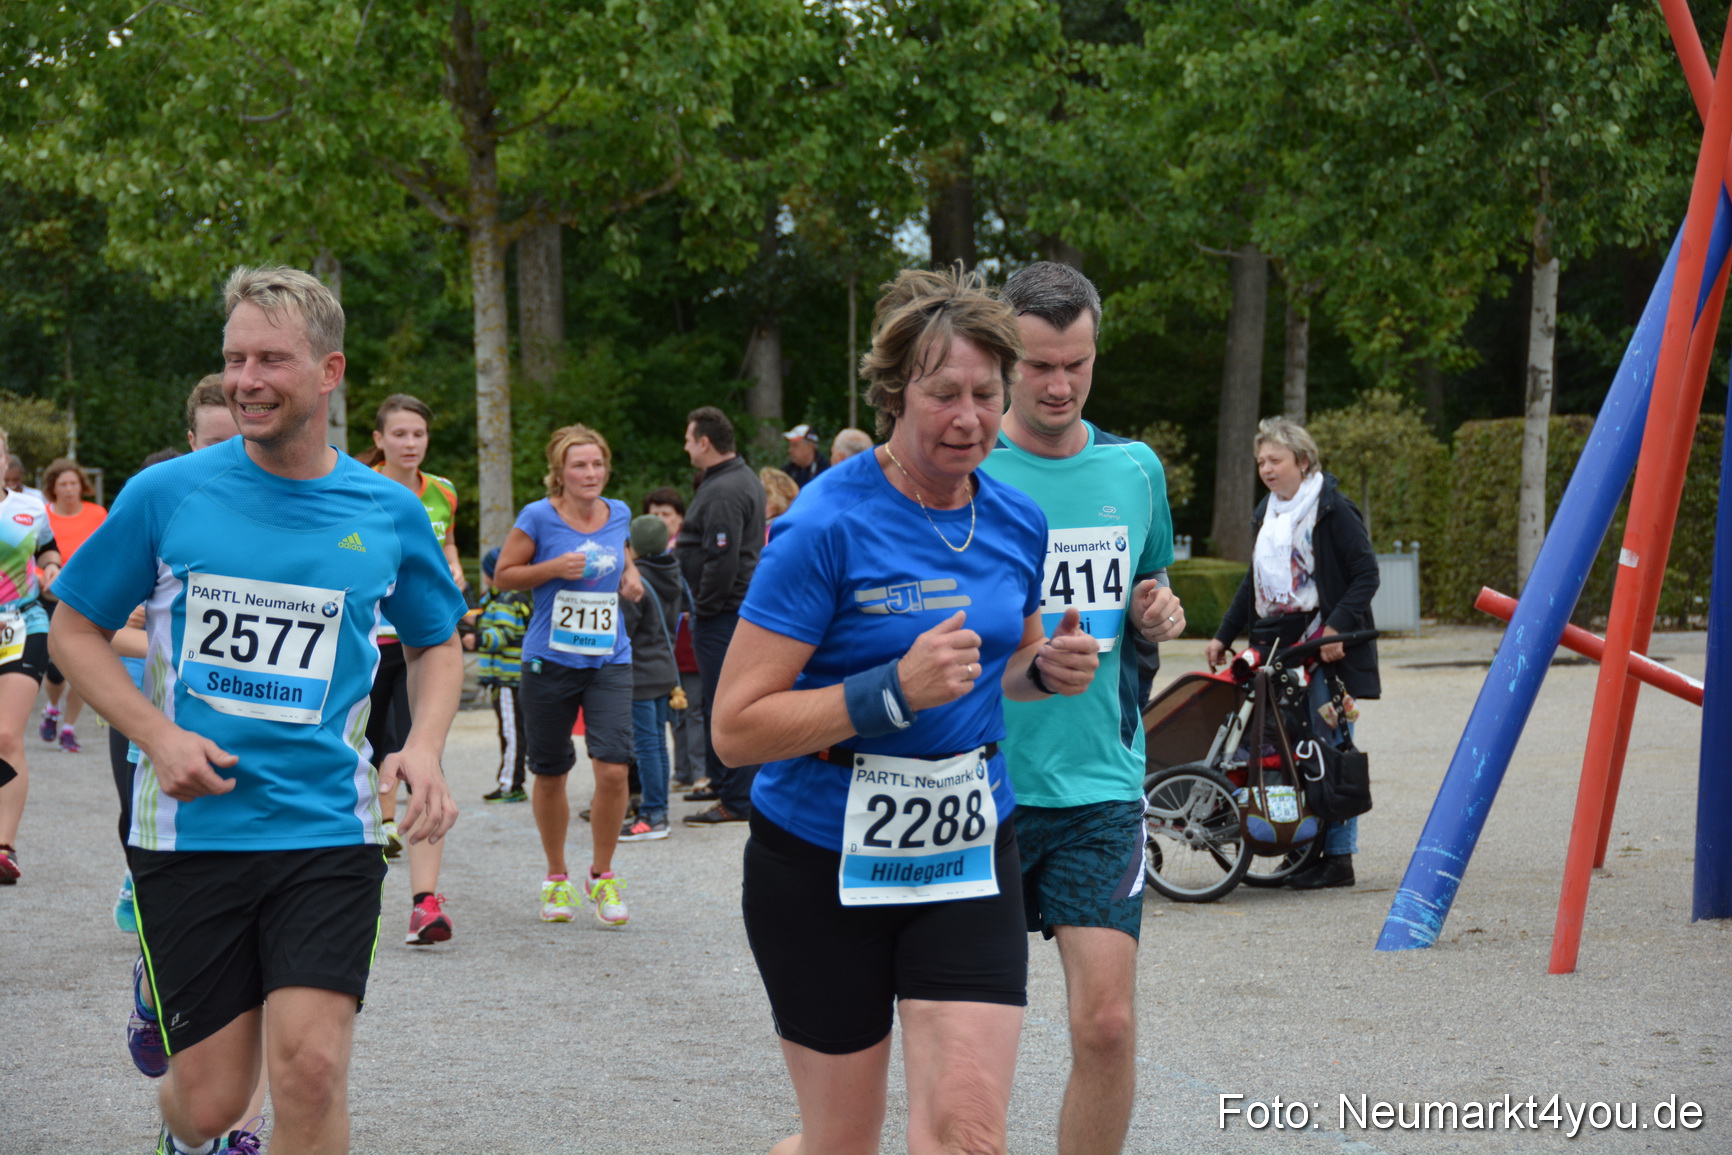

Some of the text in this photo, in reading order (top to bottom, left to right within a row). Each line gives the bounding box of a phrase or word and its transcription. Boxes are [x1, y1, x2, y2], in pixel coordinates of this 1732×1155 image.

[338, 541, 367, 552] adidas
[1054, 540, 1111, 553] Neumarkt
[1040, 558, 1123, 606] 414
[191, 585, 316, 614] PARTL Neumarkt
[560, 606, 612, 631] 2113
[199, 608, 325, 669] 2577
[573, 635, 596, 645] Petra
[206, 671, 303, 703] Sebastian
[856, 769, 975, 789] PARTL Neumarkt
[863, 789, 986, 849] 2288
[871, 855, 964, 884] Hildegard
